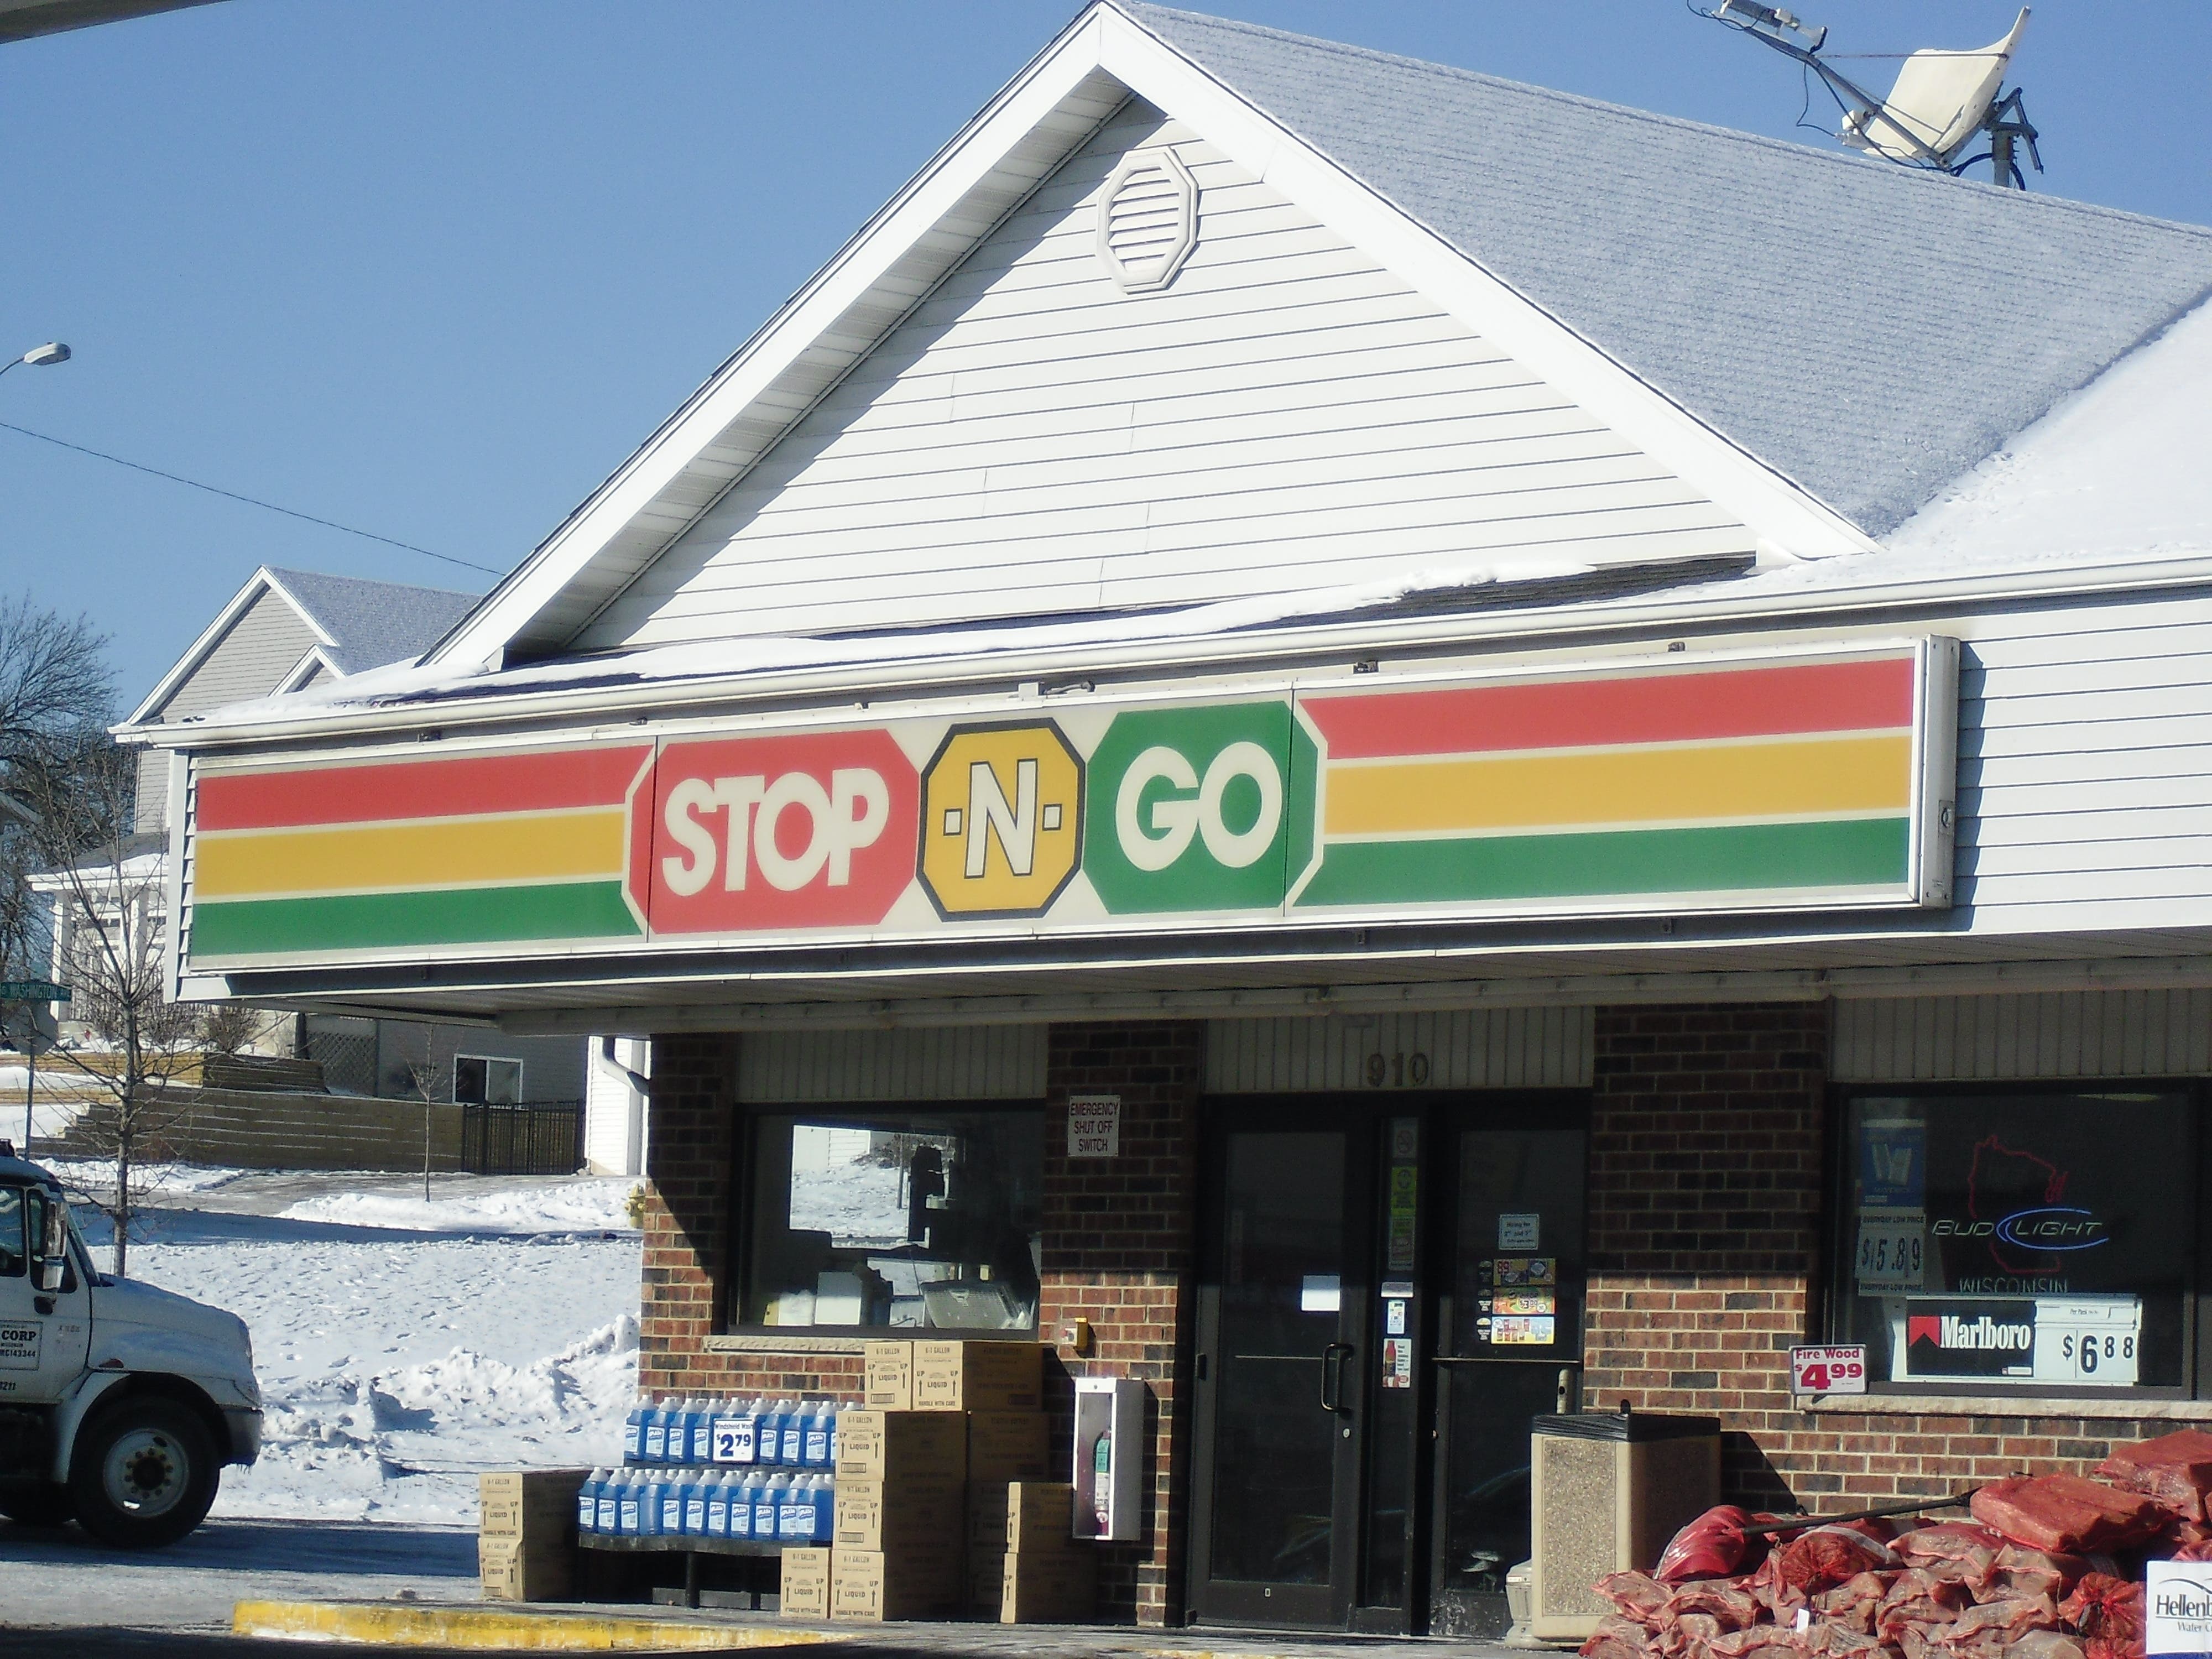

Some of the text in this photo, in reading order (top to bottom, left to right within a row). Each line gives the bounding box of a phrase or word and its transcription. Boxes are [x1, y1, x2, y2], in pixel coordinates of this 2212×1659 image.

[661, 768, 890, 896] STOP
[1115, 741, 1283, 872] GO
[1367, 1053, 1429, 1087] 910
[1070, 1102, 1118, 1116] EMERGENCY
[1074, 1120, 1113, 1134] SHUT OFF
[1078, 1138, 1108, 1152] SWITCH
[1932, 1219, 2103, 1236] BUD LIGHT
[1959, 1277, 2068, 1293] WISCONSIN
[2, 1330, 36, 1341] CORP
[1940, 1316, 2031, 1350] Marlboro
[1796, 1348, 1860, 1359] Fire Wood
[2178, 1621, 2212, 1632] Water C
